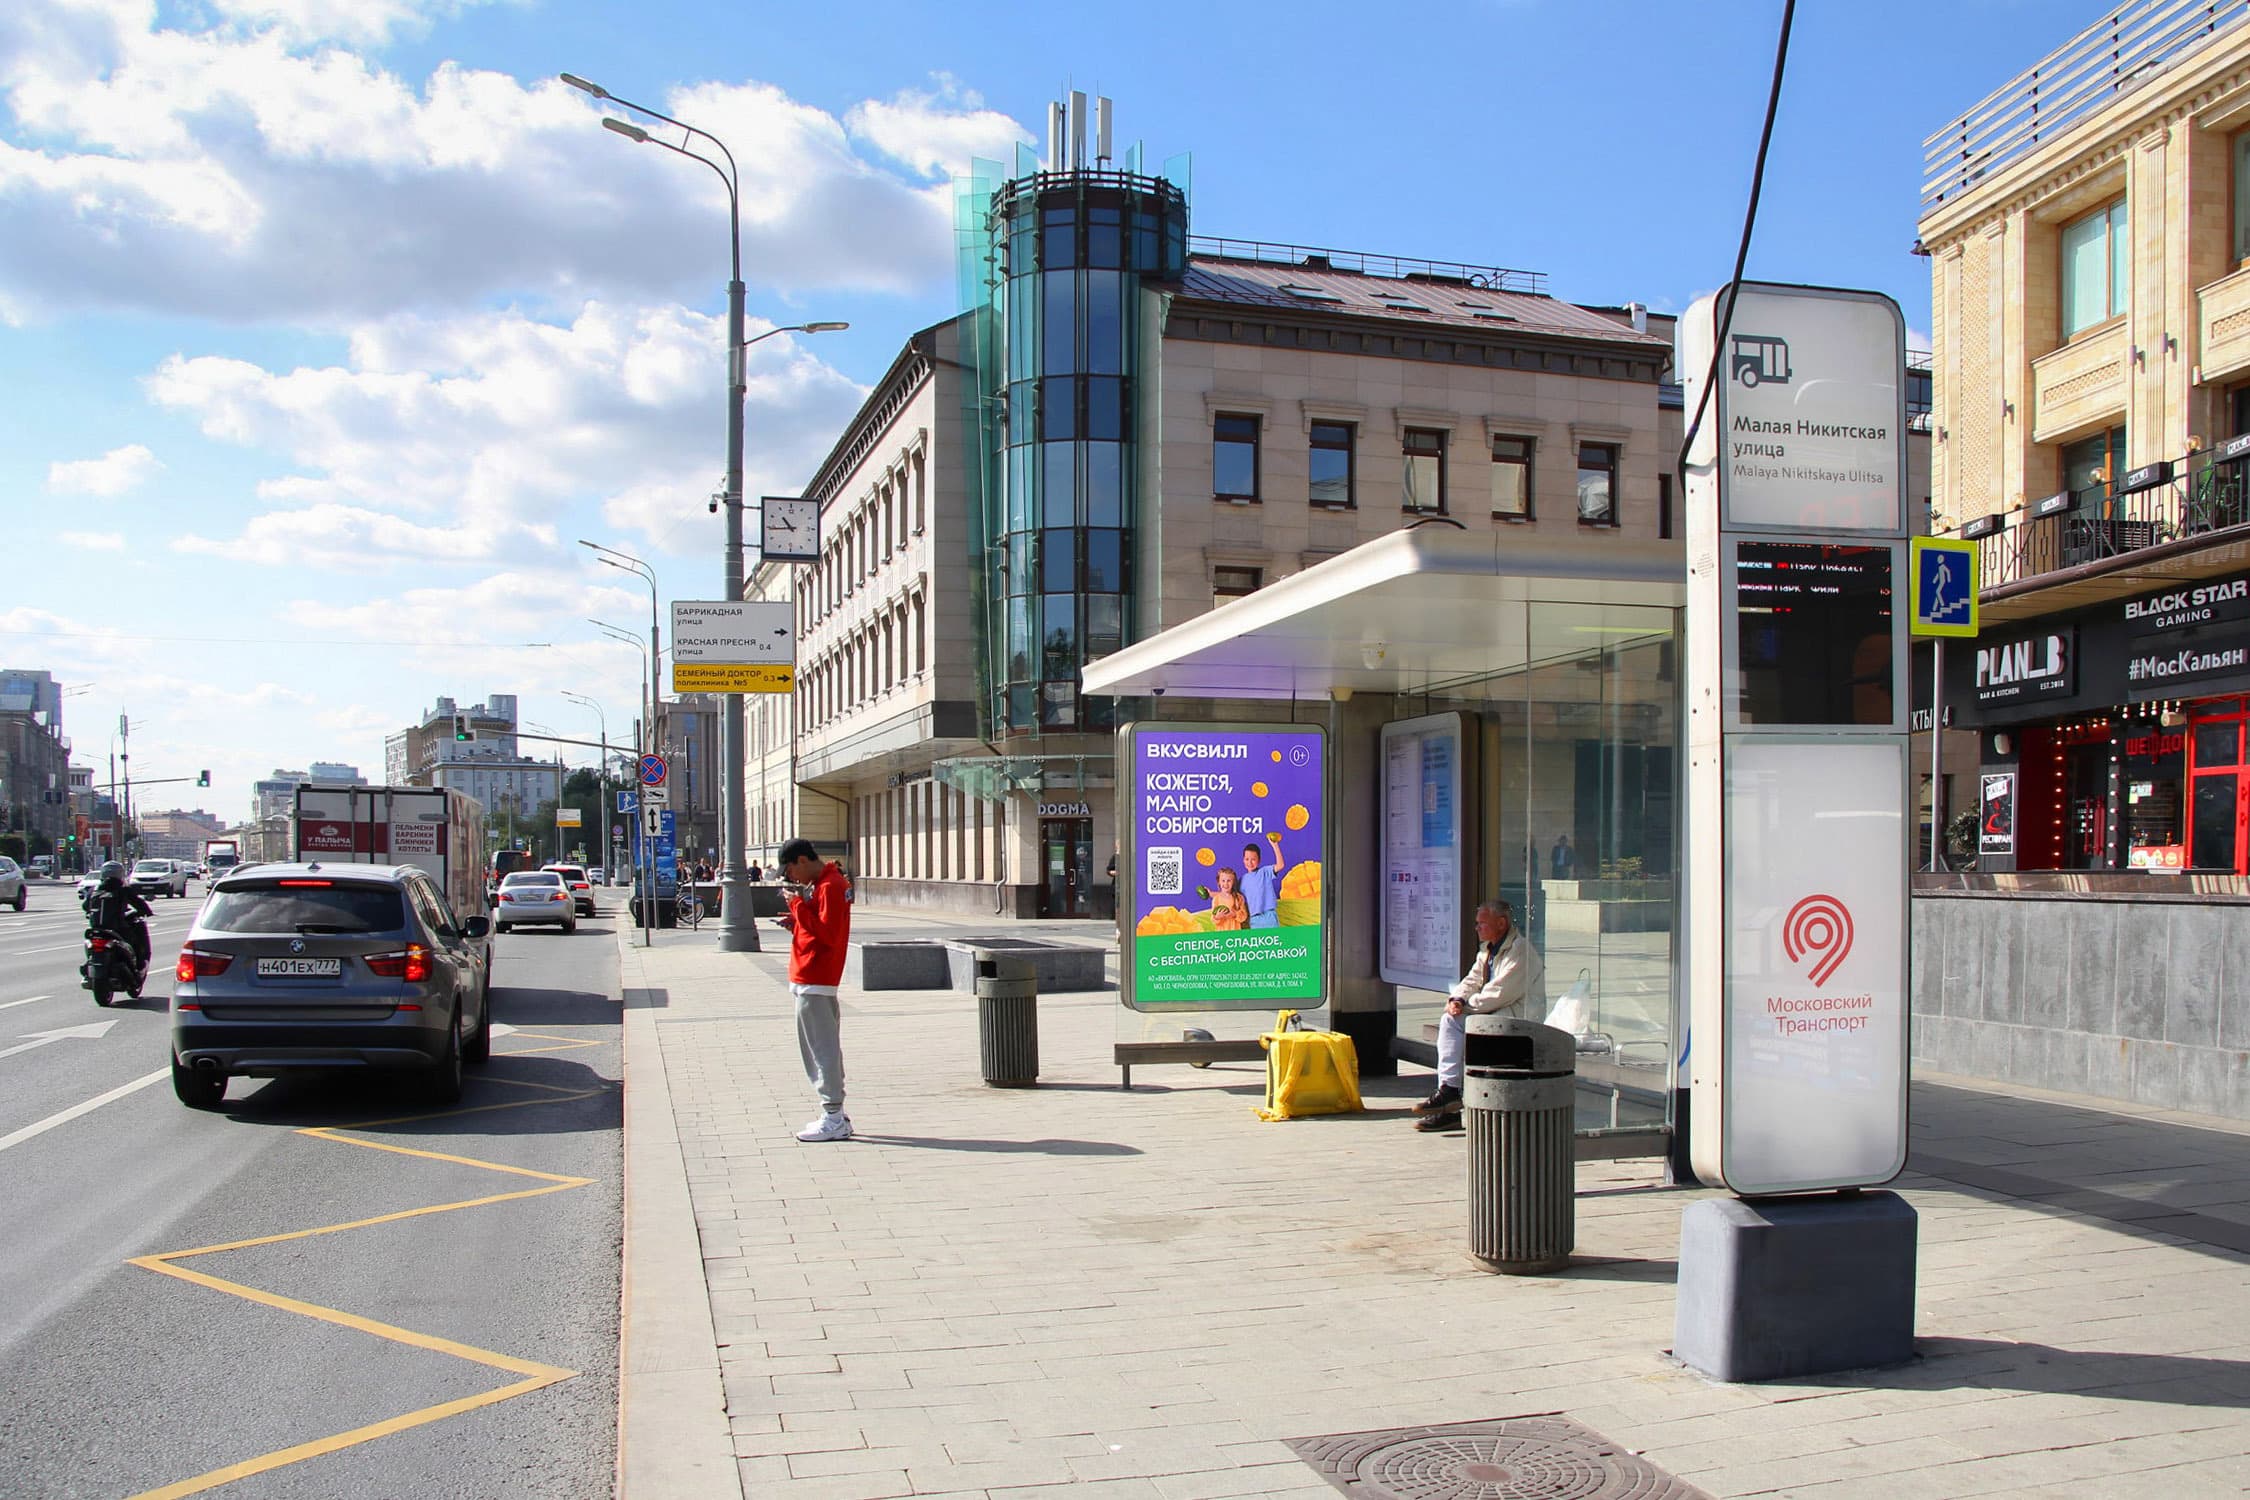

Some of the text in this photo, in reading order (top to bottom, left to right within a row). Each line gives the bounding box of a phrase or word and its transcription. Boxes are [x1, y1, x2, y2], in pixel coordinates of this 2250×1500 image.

[1733, 415, 1887, 440] Малая Никитская
[1733, 442, 1785, 458] улица
[1733, 464, 1884, 484] Malaya Nikitskaya Ulitsa
[2125, 580, 2248, 619] BLACK STAR
[676, 608, 743, 617] БАРРИКАДНАЯ
[2155, 608, 2212, 628] GAMING
[676, 618, 703, 626] улица
[677, 638, 757, 647] КРАСНАЯ ПРЕСНЯ
[677, 648, 703, 656] улица
[1976, 635, 2064, 688] PLAN_B
[2128, 647, 2245, 681] #МосКальян
[675, 668, 761, 679] СЕМЕЙНЫЙ ДОКТОР
[1147, 743, 1248, 759] ВКУСВИЛЛ
[1038, 803, 1091, 815] DOGMA
[1146, 795, 1212, 812] МАНГО
[314, 836, 351, 844] ПАЛЫЧА
[1174, 935, 1283, 952] СПЕЛОЕ, СЛАДКОЕ,
[1149, 945, 1308, 967] С БЕСПЛАТНОЙ ДОСТАВКОЙ
[1767, 993, 1873, 1013] Московский
[1775, 1015, 1869, 1037] Транспорт
